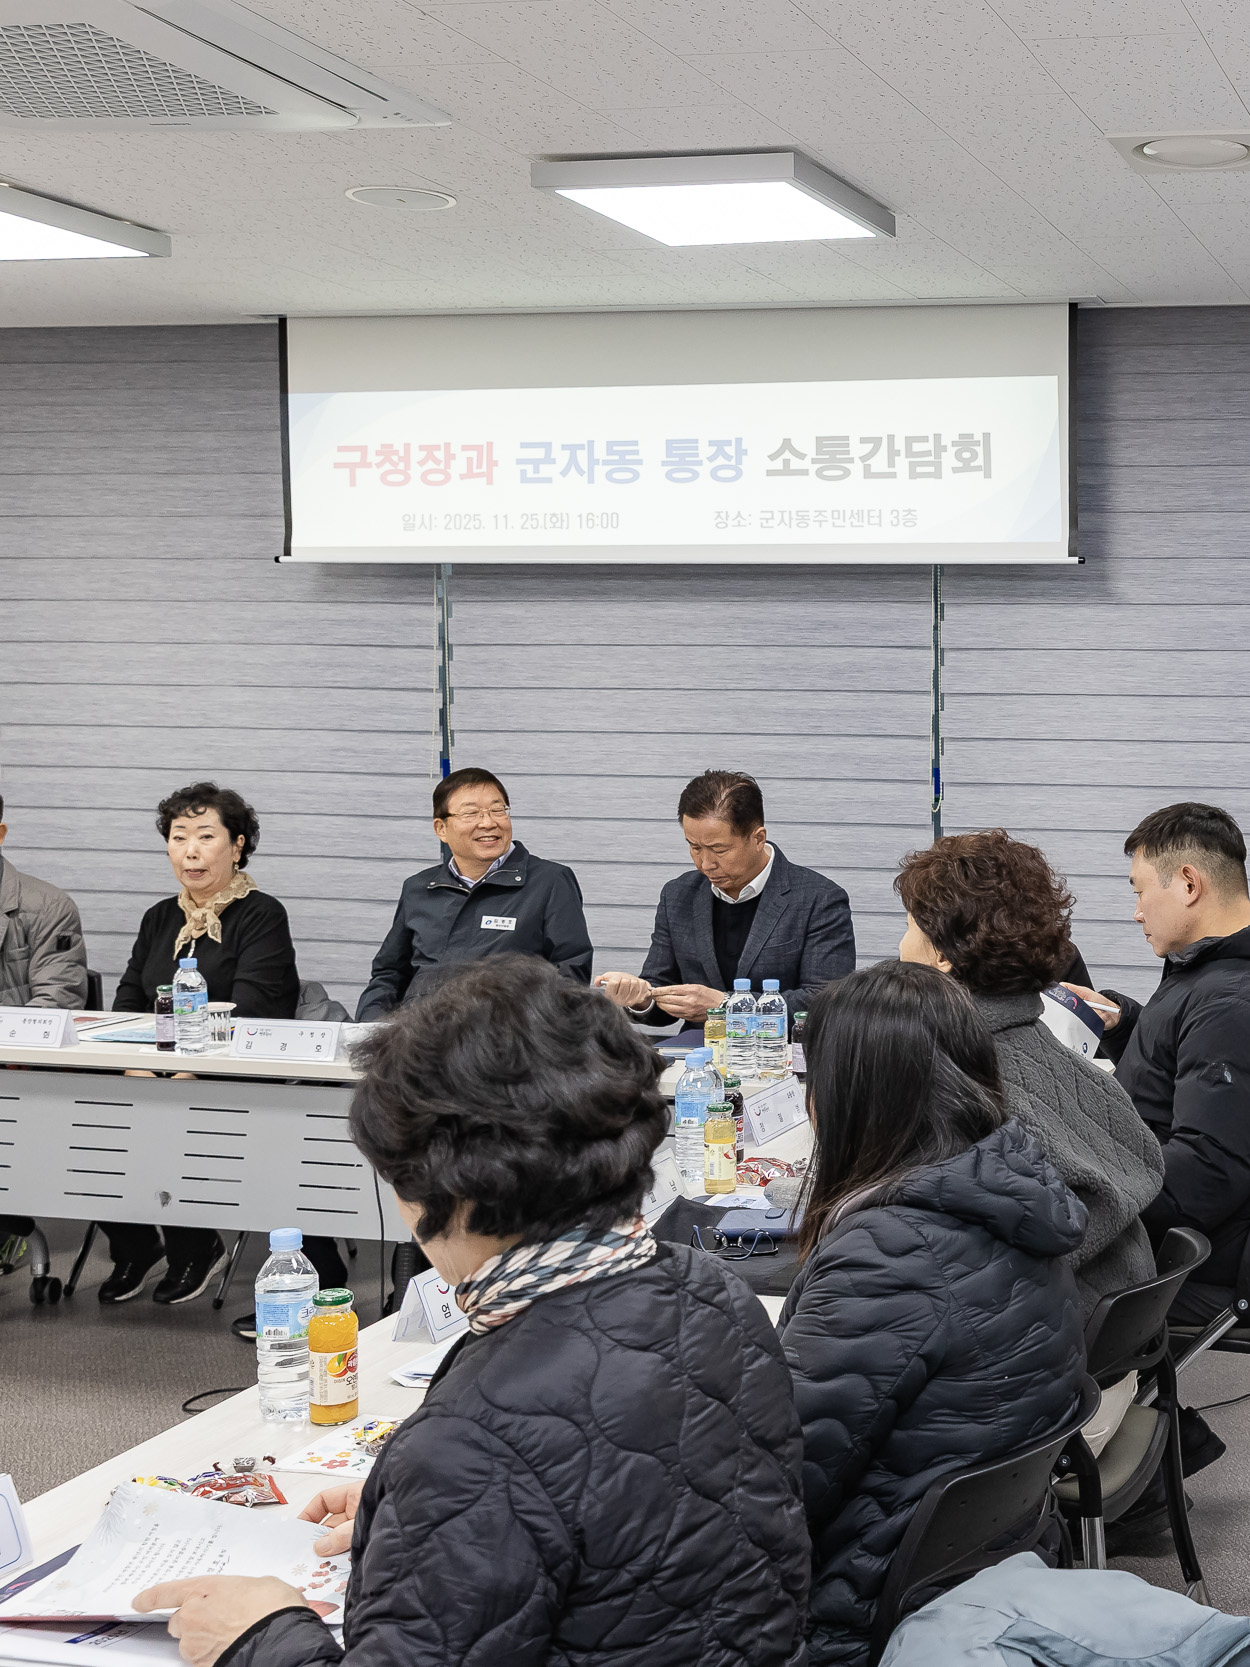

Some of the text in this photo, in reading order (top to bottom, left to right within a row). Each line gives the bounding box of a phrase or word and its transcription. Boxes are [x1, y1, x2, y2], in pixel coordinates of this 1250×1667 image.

[333, 432, 992, 487] 구청장과 군자동 통장 소통간담회
[401, 513, 438, 532] 일시:
[443, 513, 486, 531] 2025.
[492, 513, 515, 531] 11.
[577, 512, 619, 530] 16:00
[713, 508, 918, 530] 장소: 군자동주민센터 3층
[441, 1302, 452, 1319] 엄
